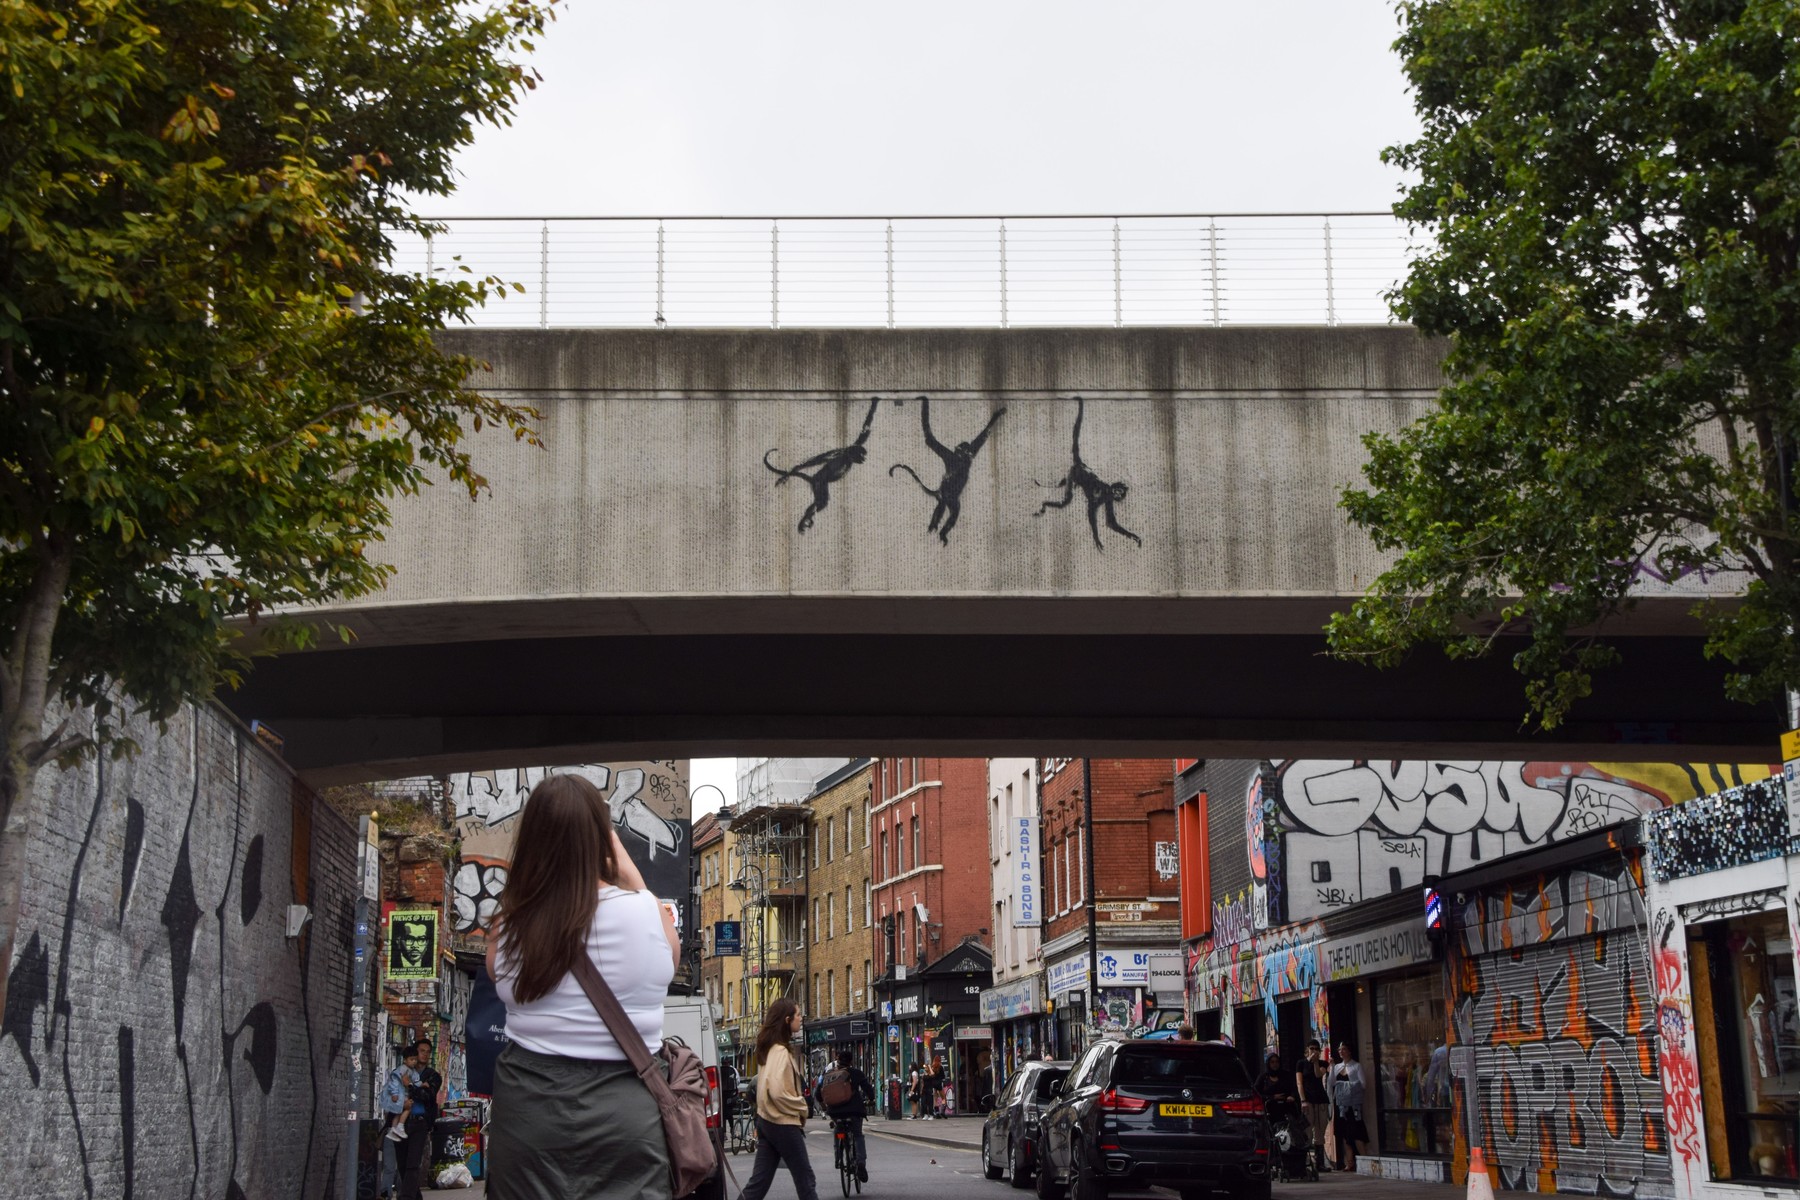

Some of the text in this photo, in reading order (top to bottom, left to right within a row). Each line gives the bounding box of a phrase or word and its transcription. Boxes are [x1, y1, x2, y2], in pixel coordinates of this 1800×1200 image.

[1020, 819, 1030, 870] BASHIR
[1022, 885, 1032, 920] SONS
[1328, 947, 1344, 970] THE
[1345, 938, 1380, 968] FUTURE
[1380, 936, 1389, 960] IS
[964, 986, 980, 994] 182
[1165, 1106, 1207, 1115] KW14 LGE
